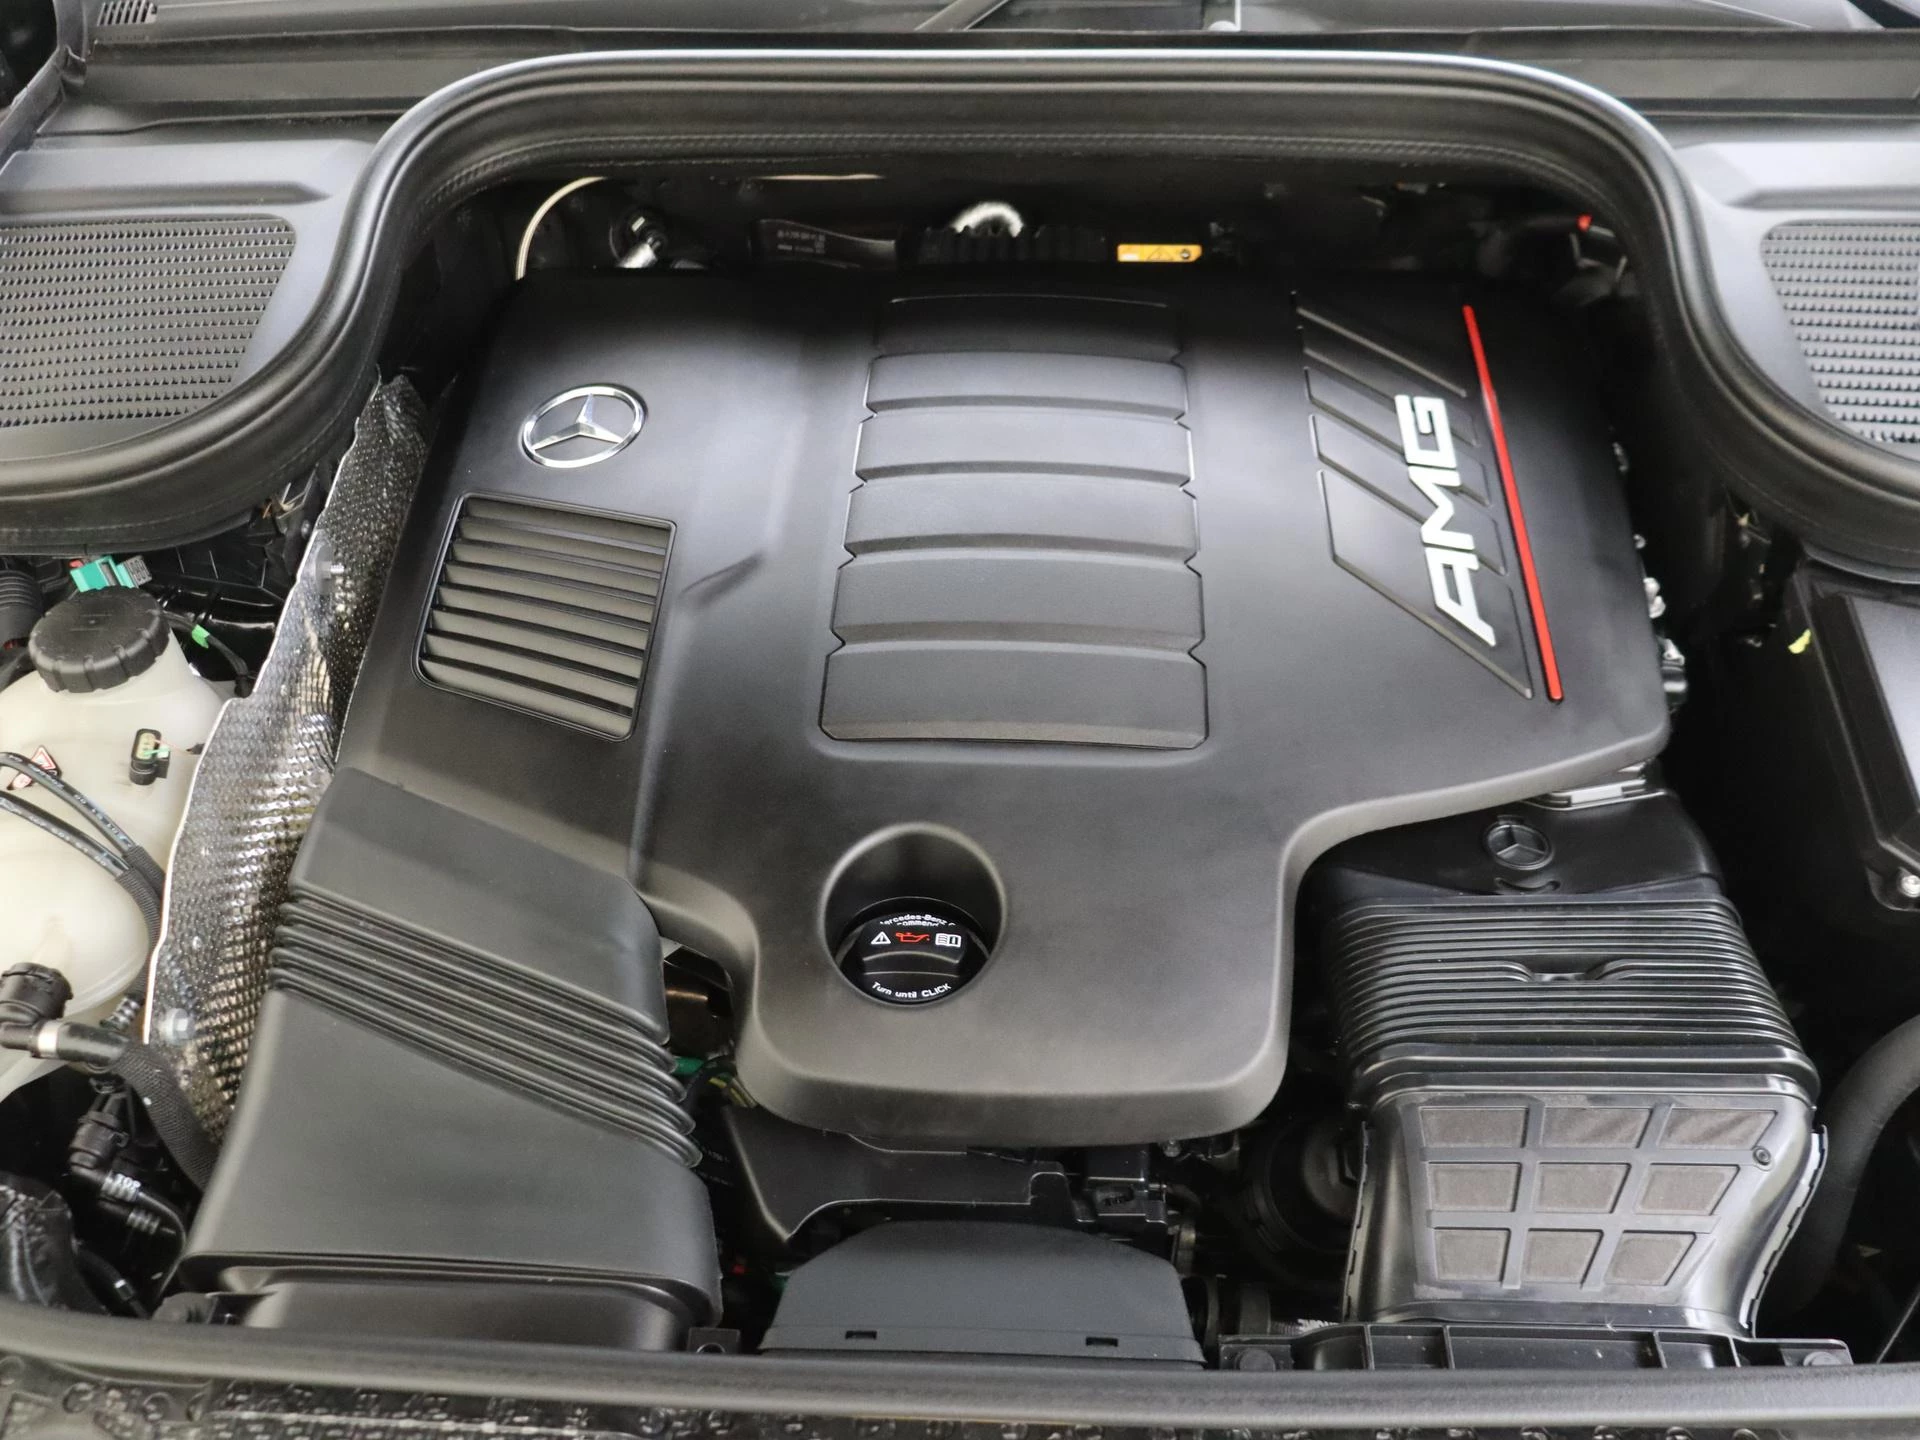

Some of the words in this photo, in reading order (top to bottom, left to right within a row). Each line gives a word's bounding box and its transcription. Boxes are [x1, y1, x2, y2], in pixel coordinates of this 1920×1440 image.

[1395, 395, 1496, 647] AMG
[872, 981, 892, 995] Turn
[921, 983, 952, 997] CLICK
